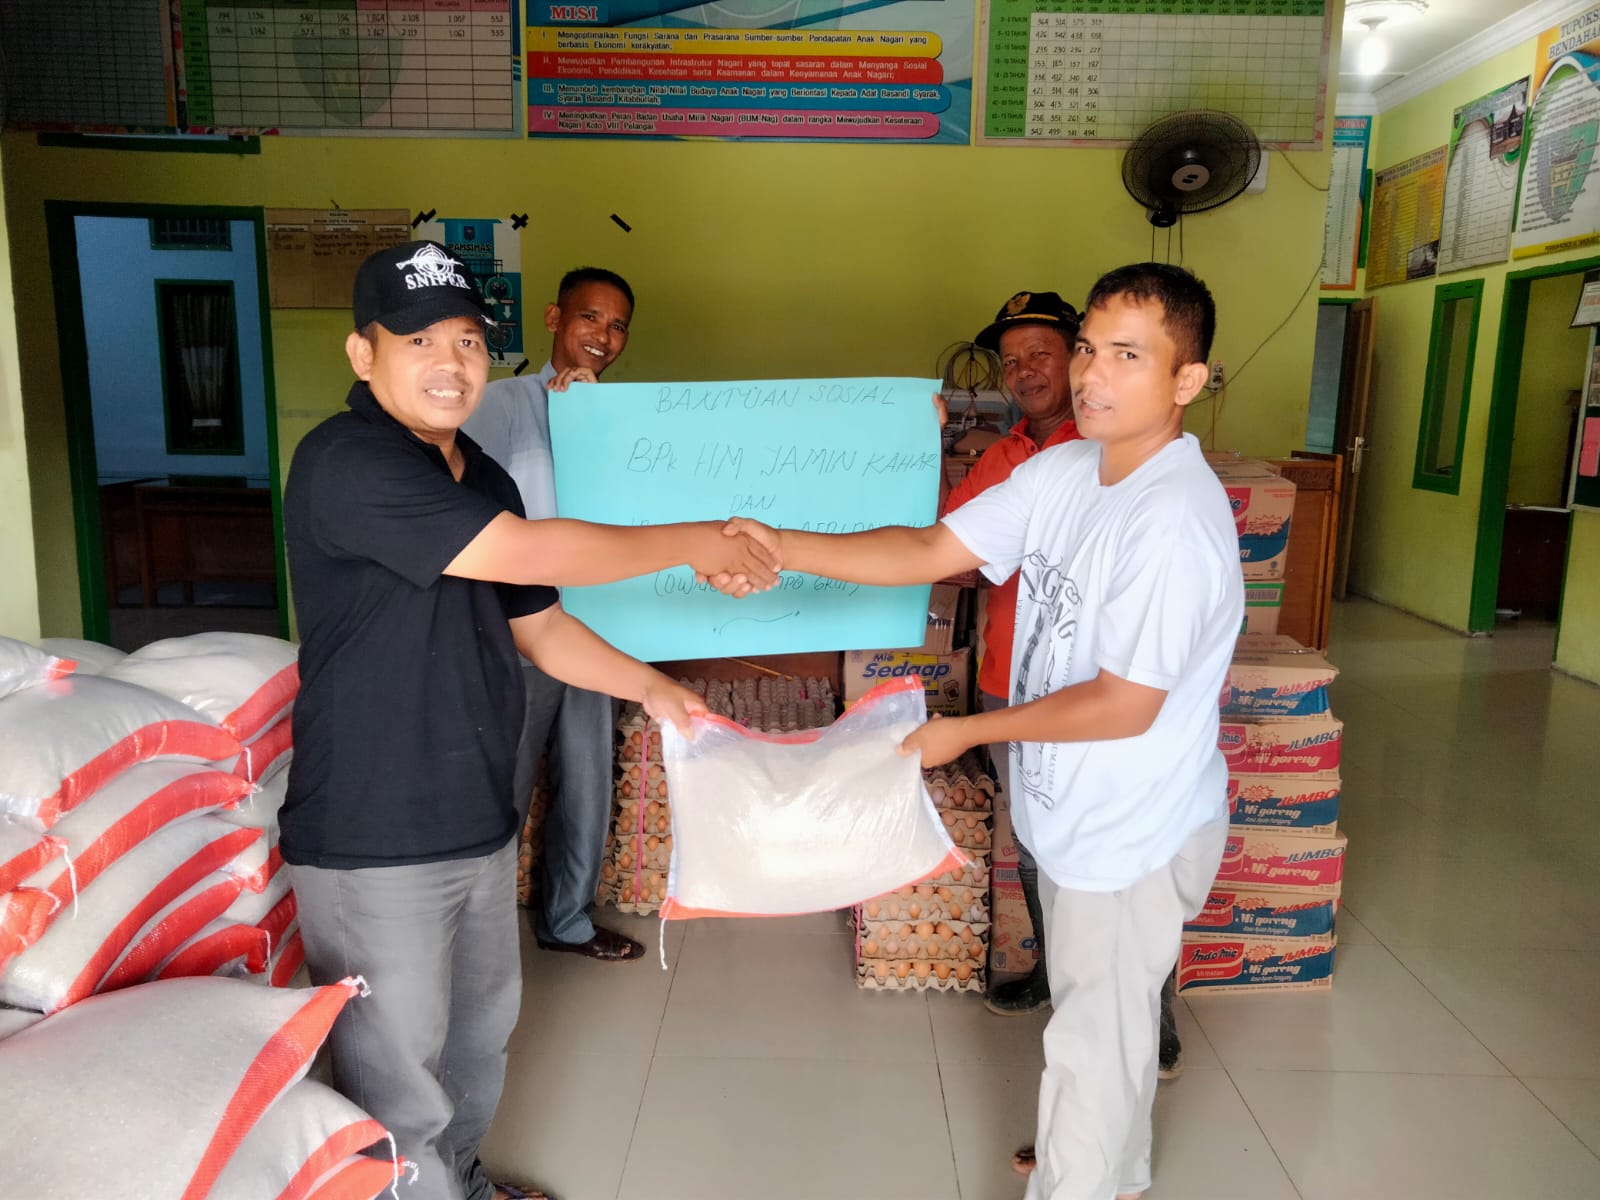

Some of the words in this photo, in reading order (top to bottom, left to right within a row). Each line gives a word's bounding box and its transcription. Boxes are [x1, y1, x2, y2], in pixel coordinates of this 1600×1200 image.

[551, 6, 598, 21] MISI
[558, 31, 619, 42] Mengoptimalkan
[624, 31, 649, 42] Fungsi
[654, 32, 679, 41] Sarana
[684, 32, 698, 41] dan
[703, 32, 740, 41] Prasarana
[809, 33, 852, 44] Pendapatan
[856, 35, 875, 43] Anak
[880, 35, 904, 45] Nagari
[909, 36, 927, 45] yang
[558, 41, 589, 49] berbasis
[594, 41, 626, 49] Ekonomi
[1549, 24, 1600, 59] BENDAHA
[717, 58, 743, 68] Nagari
[748, 60, 767, 69] yang
[795, 60, 825, 68] sasaran
[830, 60, 854, 69] dalam
[903, 61, 927, 70] Sosial
[649, 67, 688, 77] Kesehatan
[716, 69, 756, 77] Keamanan
[761, 69, 785, 77] dalam
[842, 70, 862, 79] Anak
[690, 86, 717, 97] Budaya
[720, 87, 739, 96] Anak
[742, 87, 766, 98] Nagari
[769, 88, 788, 98] yang
[831, 88, 857, 98] Kepada
[861, 89, 878, 97] Adat
[881, 89, 910, 98] Basandi
[586, 95, 614, 104] Basandi
[558, 110, 607, 121] Meningkatkan
[611, 111, 632, 120] Peran
[636, 111, 657, 120] Badan
[662, 112, 684, 121] Usaha
[711, 113, 734, 123] Nagari
[782, 114, 804, 123] dalam
[808, 115, 832, 125] rangka
[836, 116, 880, 126] Mewujudkan
[558, 120, 582, 131] Nagari
[447, 243, 492, 252] PAMSIMAS
[405, 271, 471, 290] SNIPER
[809, 384, 896, 406] SOSIAL
[760, 444, 857, 477] JAMIN
[729, 494, 776, 513] DAN
[862, 660, 951, 680] Sedaap
[1285, 729, 1342, 752] JUMBO
[1271, 755, 1321, 767] goreng
[1277, 788, 1339, 807] JUMBO
[1259, 807, 1301, 819] goreng
[1283, 846, 1345, 864] JUMBO
[1267, 867, 1321, 881] goreng
[1255, 916, 1297, 928] goreng
[1262, 965, 1302, 976] goreng
